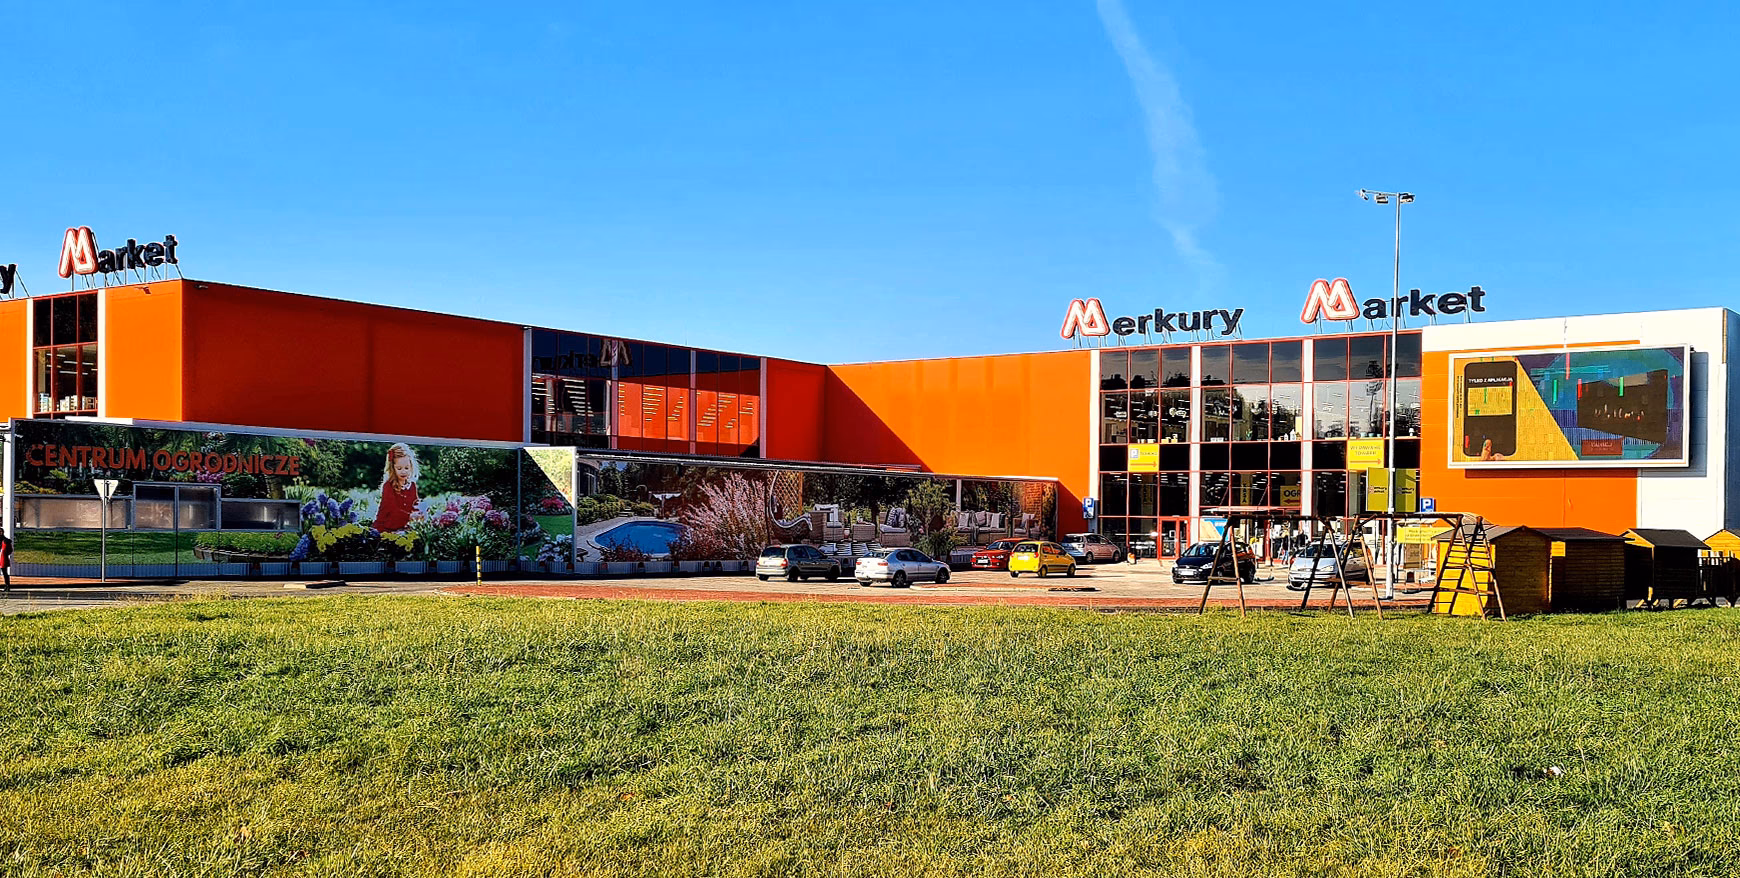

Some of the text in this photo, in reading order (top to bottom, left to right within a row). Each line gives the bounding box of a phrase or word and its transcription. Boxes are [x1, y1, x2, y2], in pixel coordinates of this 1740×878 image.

[58, 226, 178, 279] Market
[1061, 278, 1486, 339] Merkury Market
[26, 444, 300, 476] CENTRUM OGRODNICZE
[1422, 498, 1431, 510] P
